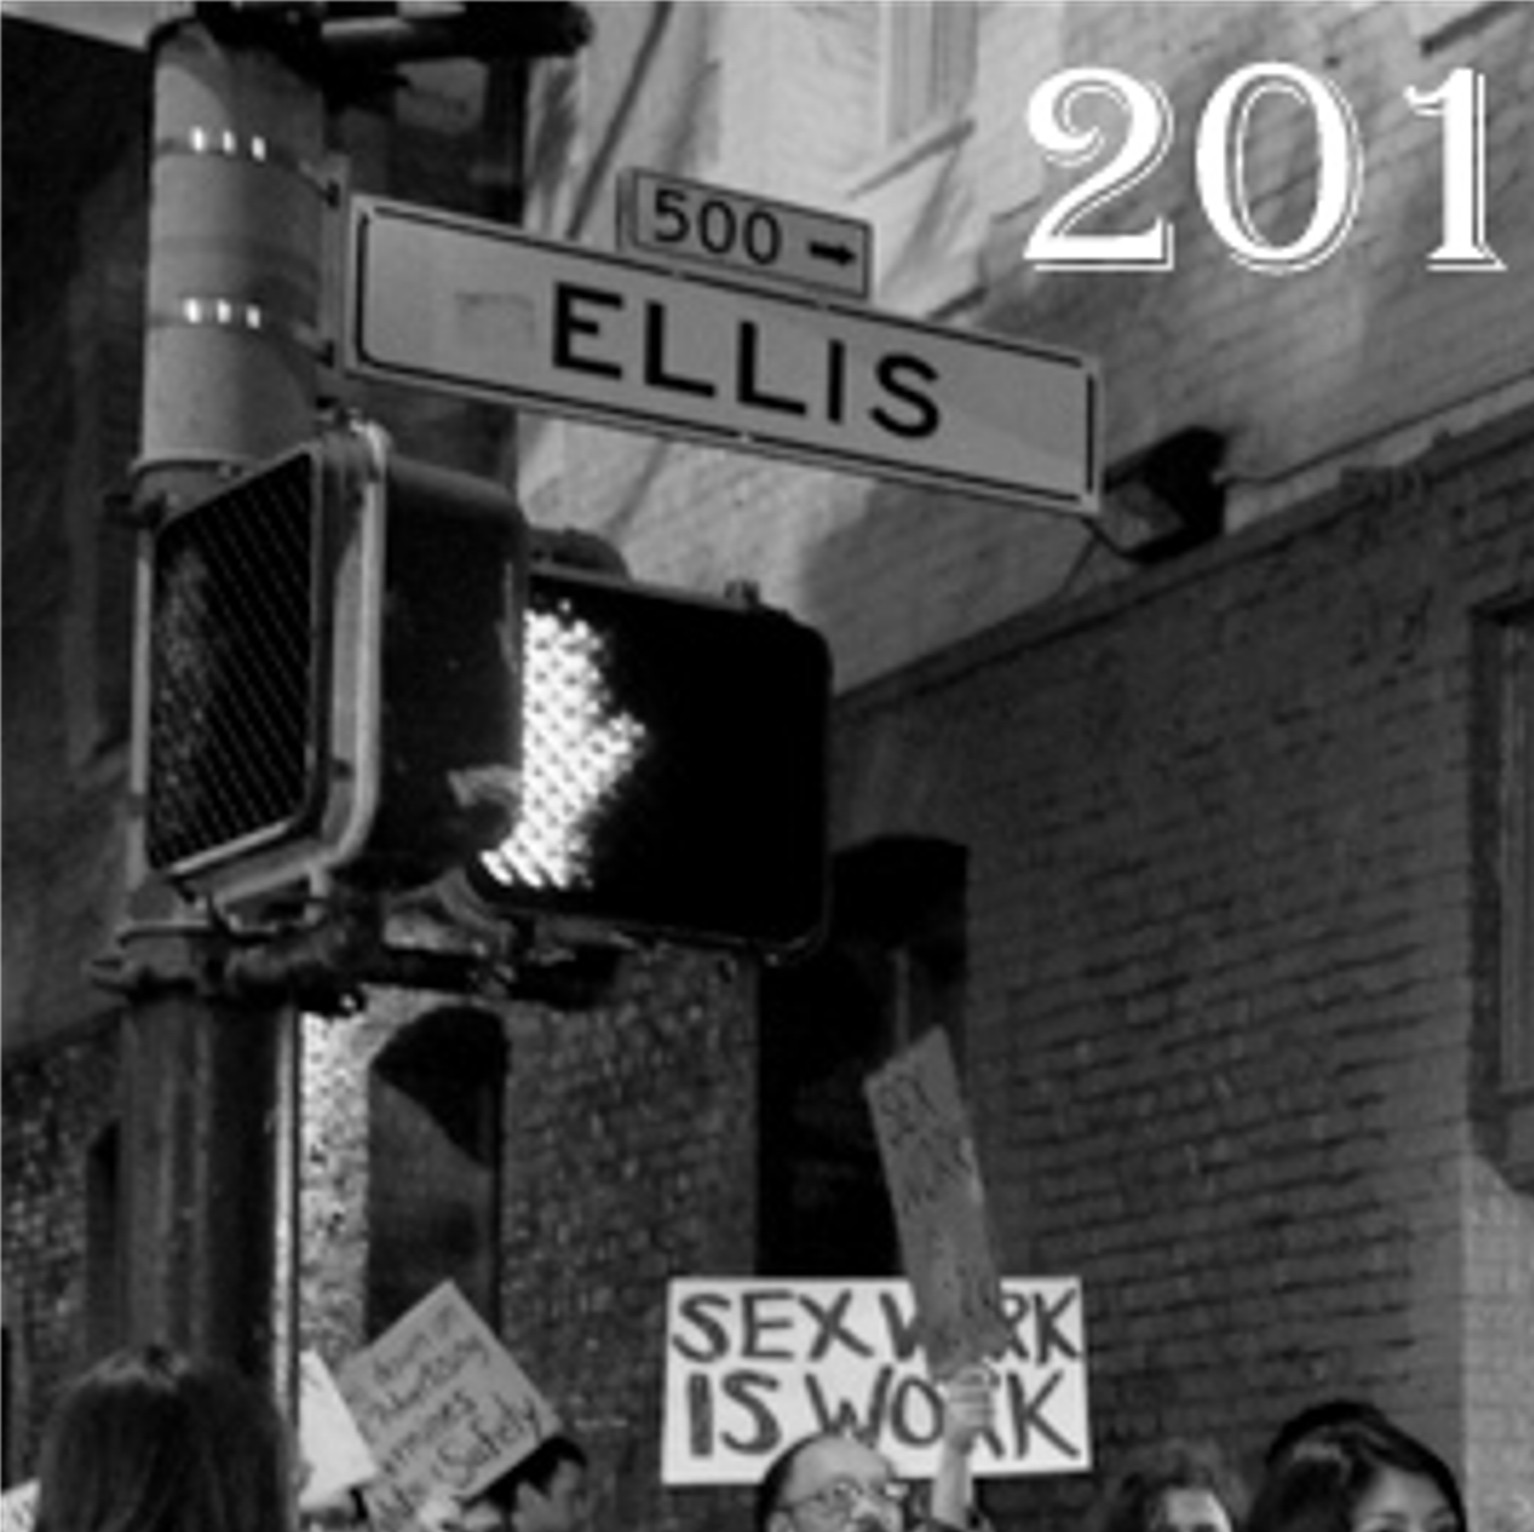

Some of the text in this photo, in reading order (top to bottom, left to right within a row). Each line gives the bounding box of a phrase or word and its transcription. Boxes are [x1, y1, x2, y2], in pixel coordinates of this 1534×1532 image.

[649, 189, 782, 266] 500
[550, 280, 941, 442] ELLIS
[671, 1289, 1080, 1368] SEX RK
[687, 1369, 784, 1459] IS
